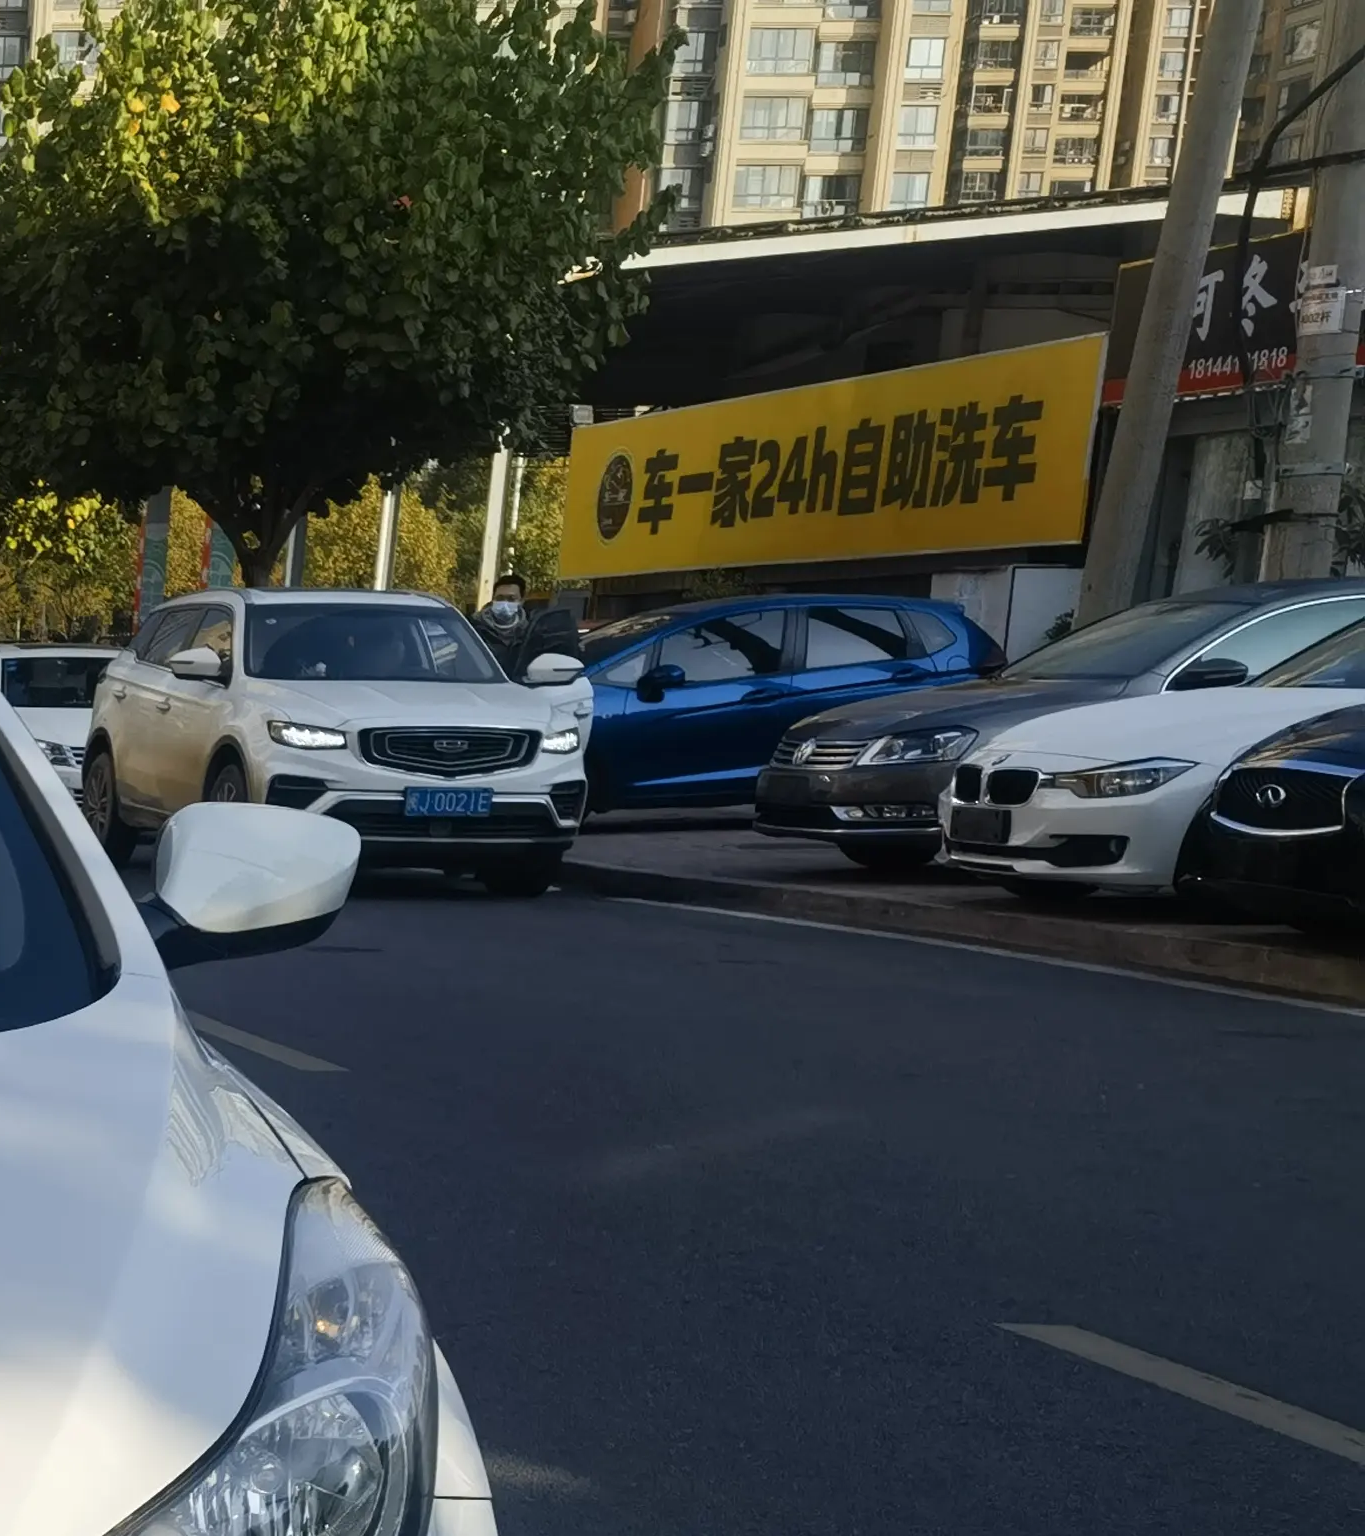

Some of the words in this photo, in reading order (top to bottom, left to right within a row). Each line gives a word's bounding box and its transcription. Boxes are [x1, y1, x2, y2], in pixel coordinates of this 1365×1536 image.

[1188, 347, 1288, 380] 1814411818
[637, 395, 1044, 535] 车一家24h自助洗车
